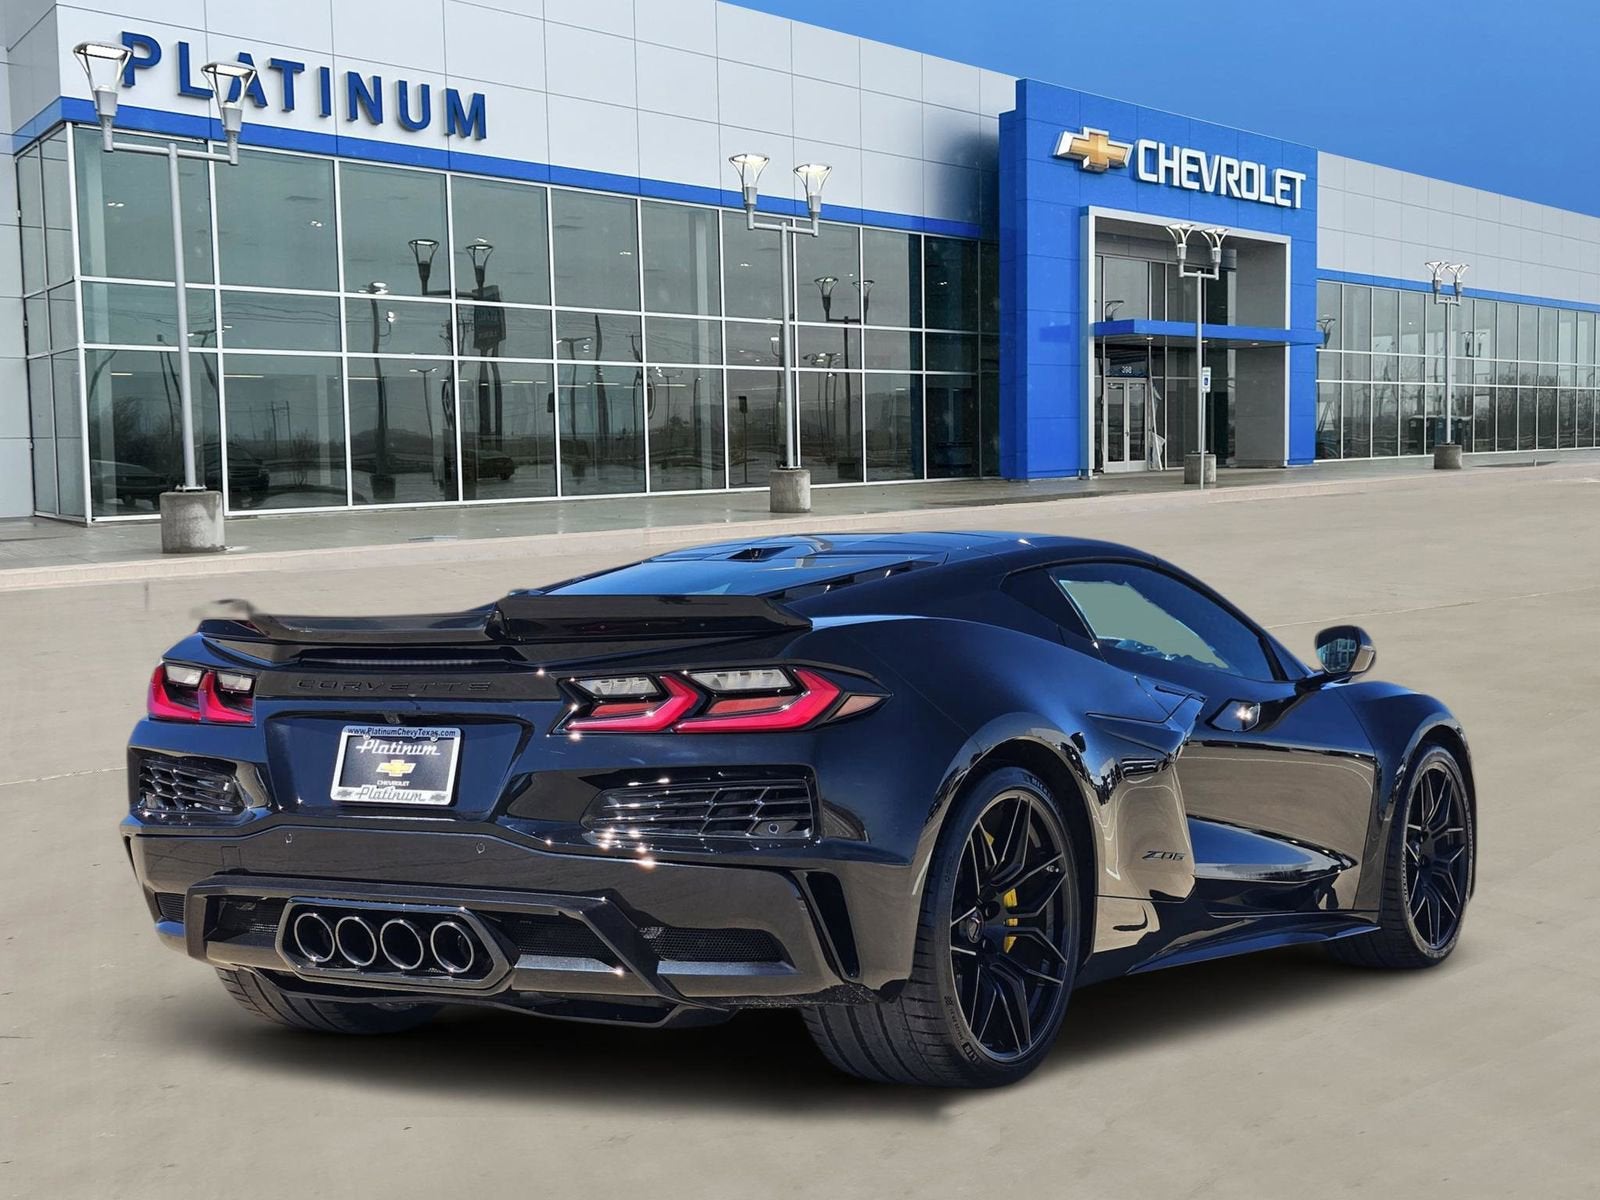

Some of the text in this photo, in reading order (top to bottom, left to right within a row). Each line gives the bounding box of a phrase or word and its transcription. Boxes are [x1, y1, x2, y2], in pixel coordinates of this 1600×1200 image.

[121, 31, 487, 141] PLATINUM
[1136, 138, 1306, 209] CHEVROLET
[296, 679, 492, 692] CORVETTE
[347, 727, 456, 738] www.PlatinumChevyTexas.com
[355, 739, 441, 756] Platinum
[354, 785, 426, 802] Platinum
[1142, 850, 1185, 860] Z06
